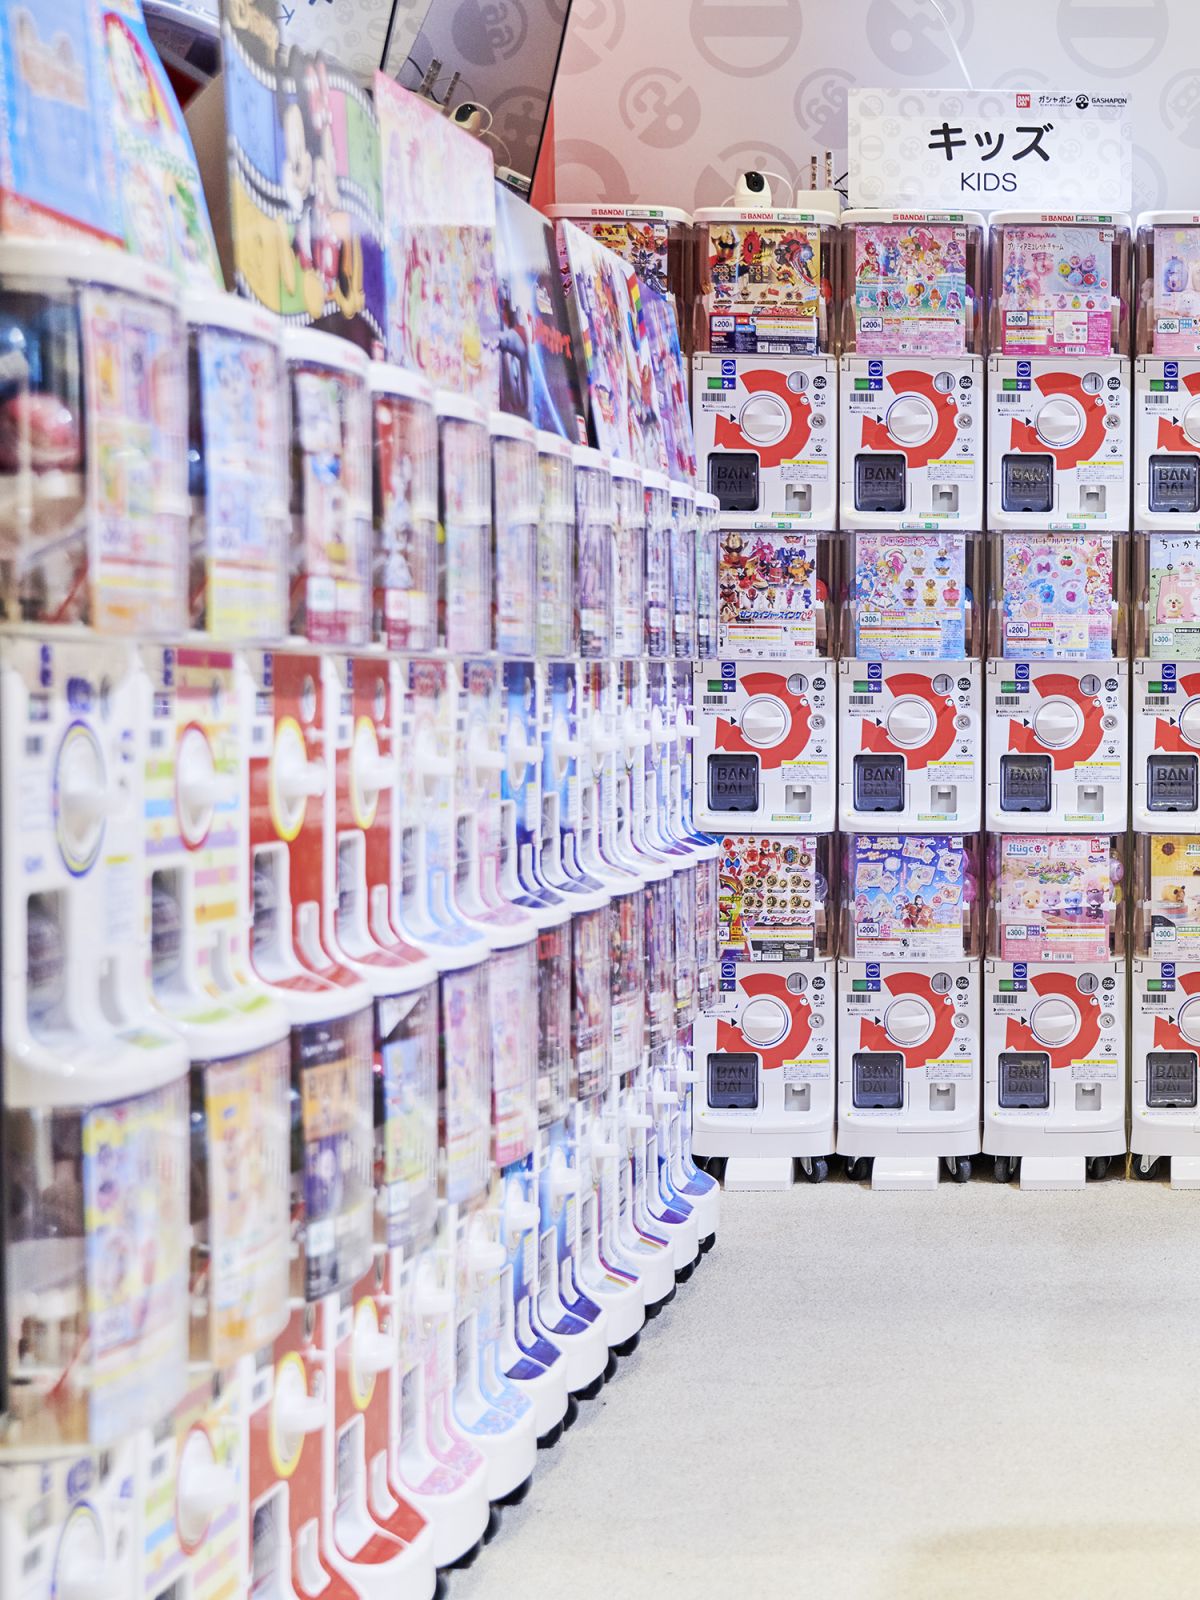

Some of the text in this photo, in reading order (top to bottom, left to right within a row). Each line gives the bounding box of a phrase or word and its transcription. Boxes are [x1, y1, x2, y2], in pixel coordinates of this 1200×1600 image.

[1038, 95, 1073, 104] ガシャポン
[1091, 97, 1127, 105] GASHAPON
[927, 122, 1054, 162] キッズ
[960, 172, 1018, 192] KIDS
[1158, 468, 1190, 480] BAN
[718, 767, 749, 780] BAN
[863, 768, 895, 780] BAN
[1157, 768, 1188, 780] BAN
